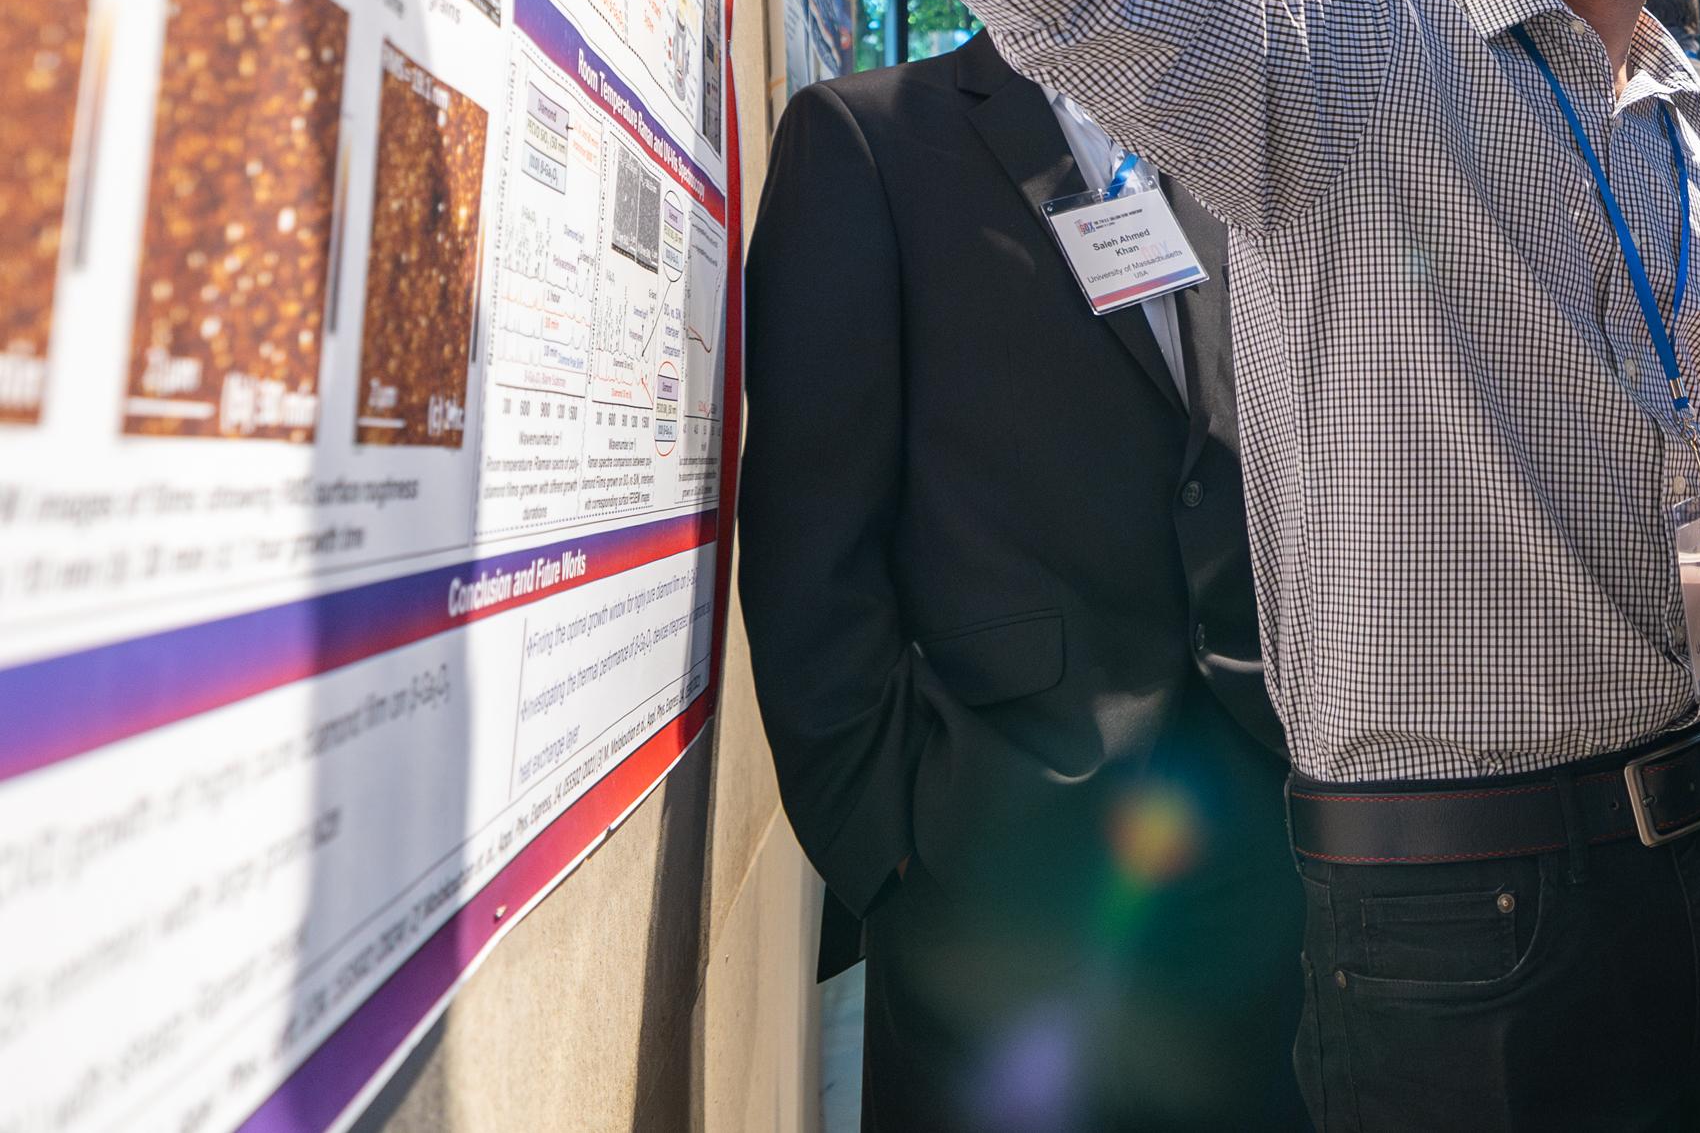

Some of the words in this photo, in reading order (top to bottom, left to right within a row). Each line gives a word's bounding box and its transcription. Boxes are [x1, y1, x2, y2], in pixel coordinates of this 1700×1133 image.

[537, 97, 558, 124] Diamond
[577, 47, 598, 93] Room
[598, 70, 638, 129] Temperature
[637, 108, 654, 151] Raman
[653, 133, 664, 160] and
[663, 137, 678, 172] UV-Vis
[678, 156, 705, 202] Spectroscopy
[1092, 237, 1119, 252] Saleh
[1119, 227, 1150, 243] Ahmed
[1115, 243, 1140, 257] Khan
[1087, 266, 1123, 284] University
[1123, 264, 1132, 274] of
[1131, 249, 1183, 270] Massachusetts
[1133, 269, 1149, 280] USA
[519, 400, 531, 416] 600
[540, 402, 551, 418] 900
[518, 430, 553, 446] Wavenumber
[608, 438, 629, 451] Wavenumber
[501, 458, 534, 474] temperature
[522, 506, 548, 522] durations
[448, 568, 511, 617] Conclusion
[512, 560, 535, 598] and
[535, 553, 560, 591] Future
[560, 548, 586, 583] Works
[532, 629, 553, 656] Finding
[554, 621, 566, 646] the
[566, 615, 588, 648] optimal
[587, 604, 609, 638] growth
[608, 600, 627, 629] window
[626, 592, 634, 619] for
[656, 575, 672, 605] diamond
[566, 674, 578, 698] the
[577, 661, 600, 694] thermal
[599, 650, 629, 682] performance
[532, 739, 565, 780] exchange
[564, 723, 581, 758] layer
